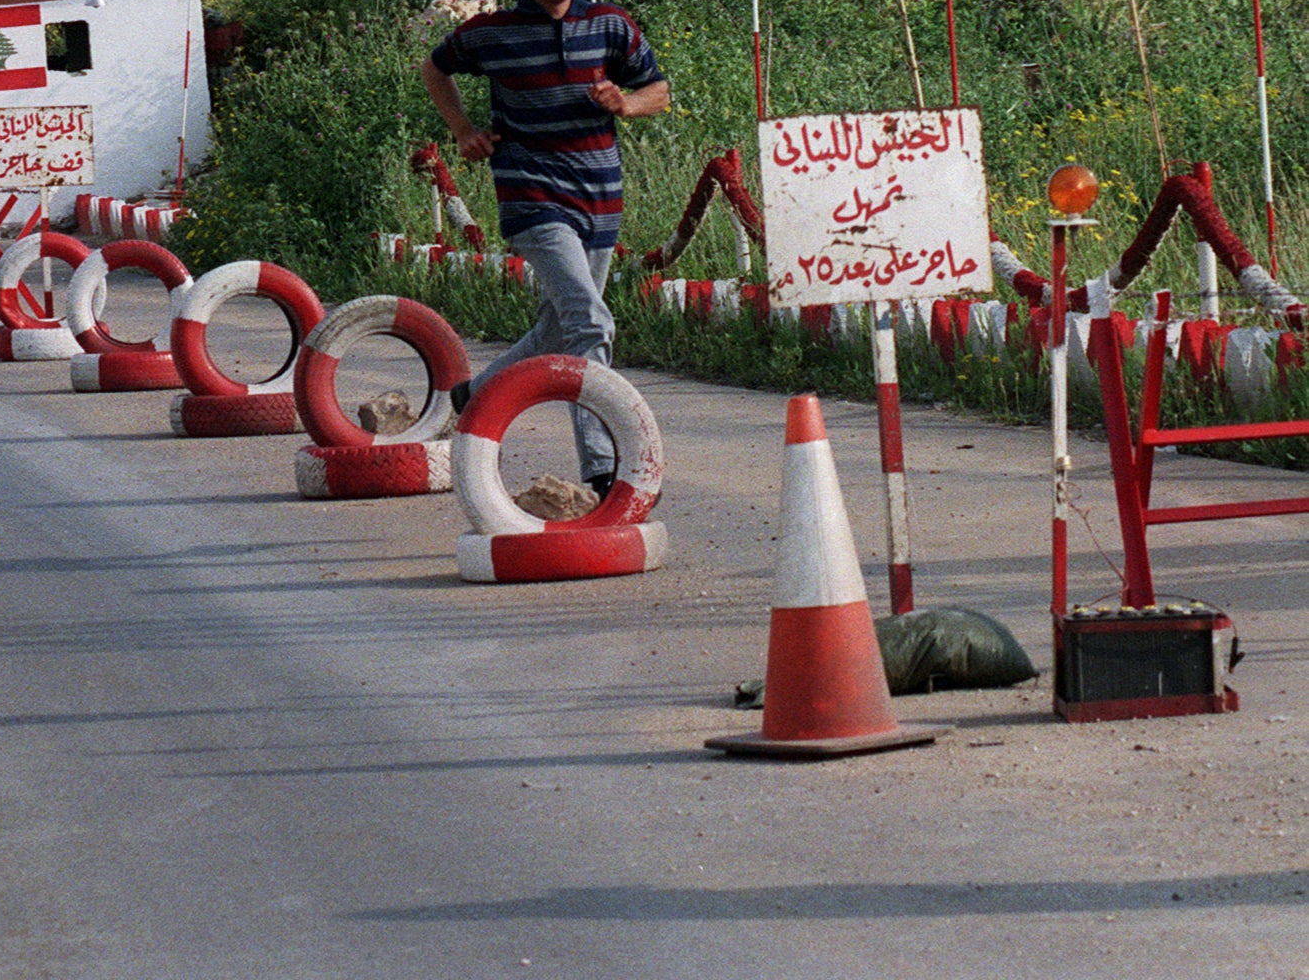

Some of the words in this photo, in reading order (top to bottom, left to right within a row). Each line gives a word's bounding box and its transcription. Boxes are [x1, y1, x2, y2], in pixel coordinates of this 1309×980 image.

[36, 111, 84, 140] الجيش
[773, 114, 863, 174] اللبناني
[855, 112, 965, 170] الجيش
[47, 150, 84, 174] قف
[832, 174, 904, 224] تمهل
[830, 259, 877, 288] بعد
[909, 239, 979, 286] حاجز
